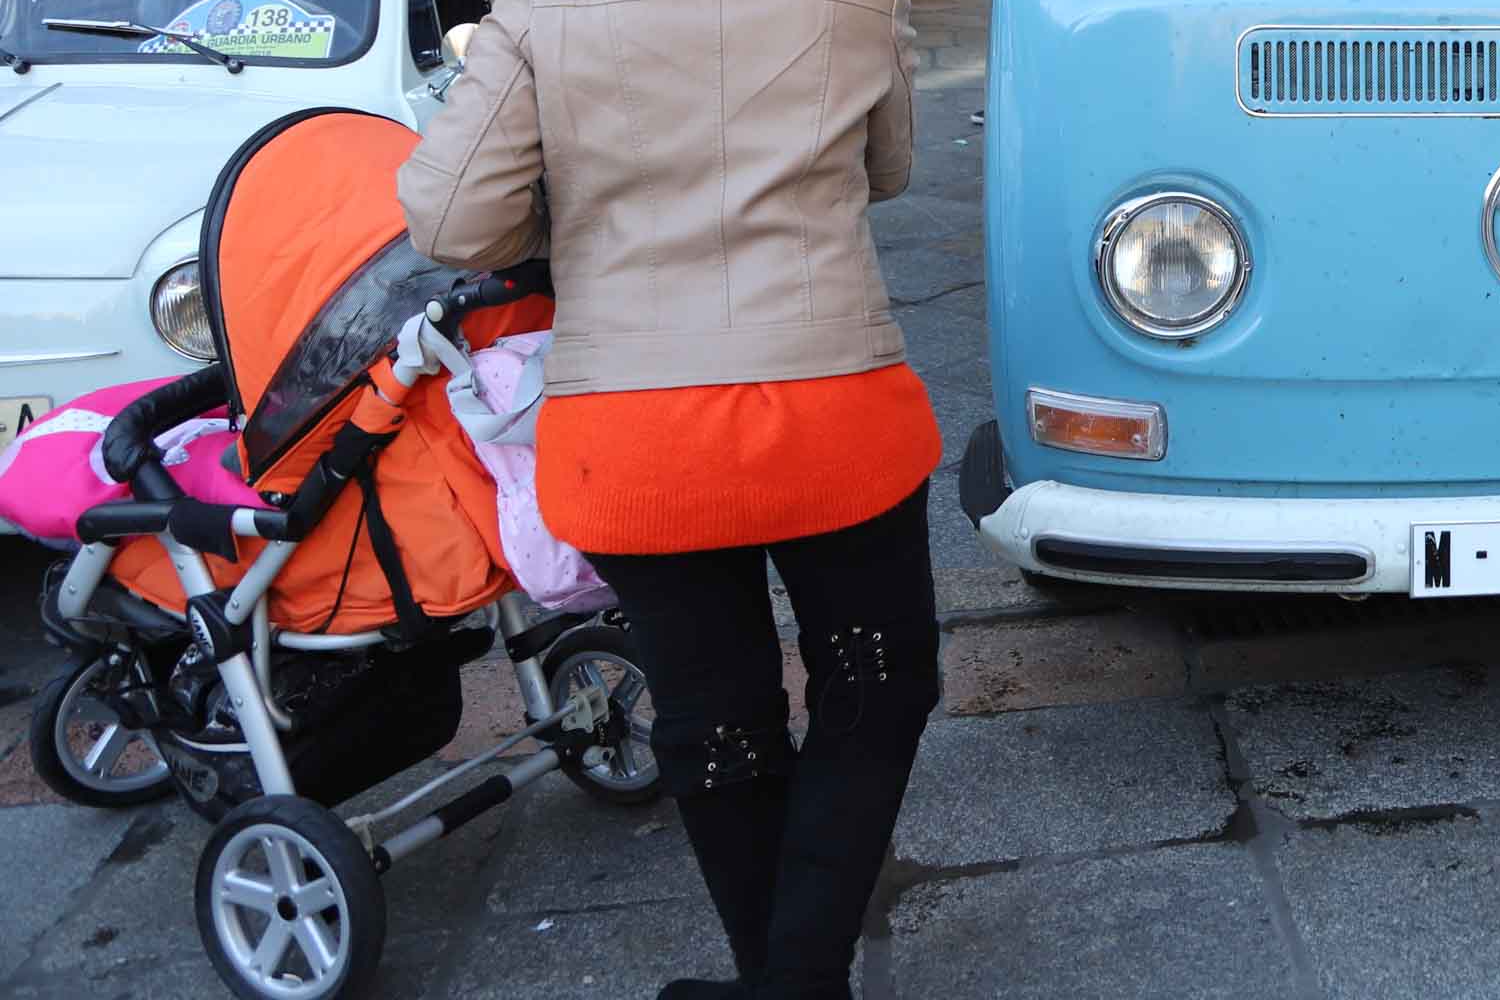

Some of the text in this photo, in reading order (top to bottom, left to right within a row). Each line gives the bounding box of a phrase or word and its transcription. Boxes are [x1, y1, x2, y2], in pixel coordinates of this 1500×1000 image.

[250, 8, 289, 28] 138
[207, 34, 257, 48] GUARDIA
[261, 32, 313, 45] URBANO
